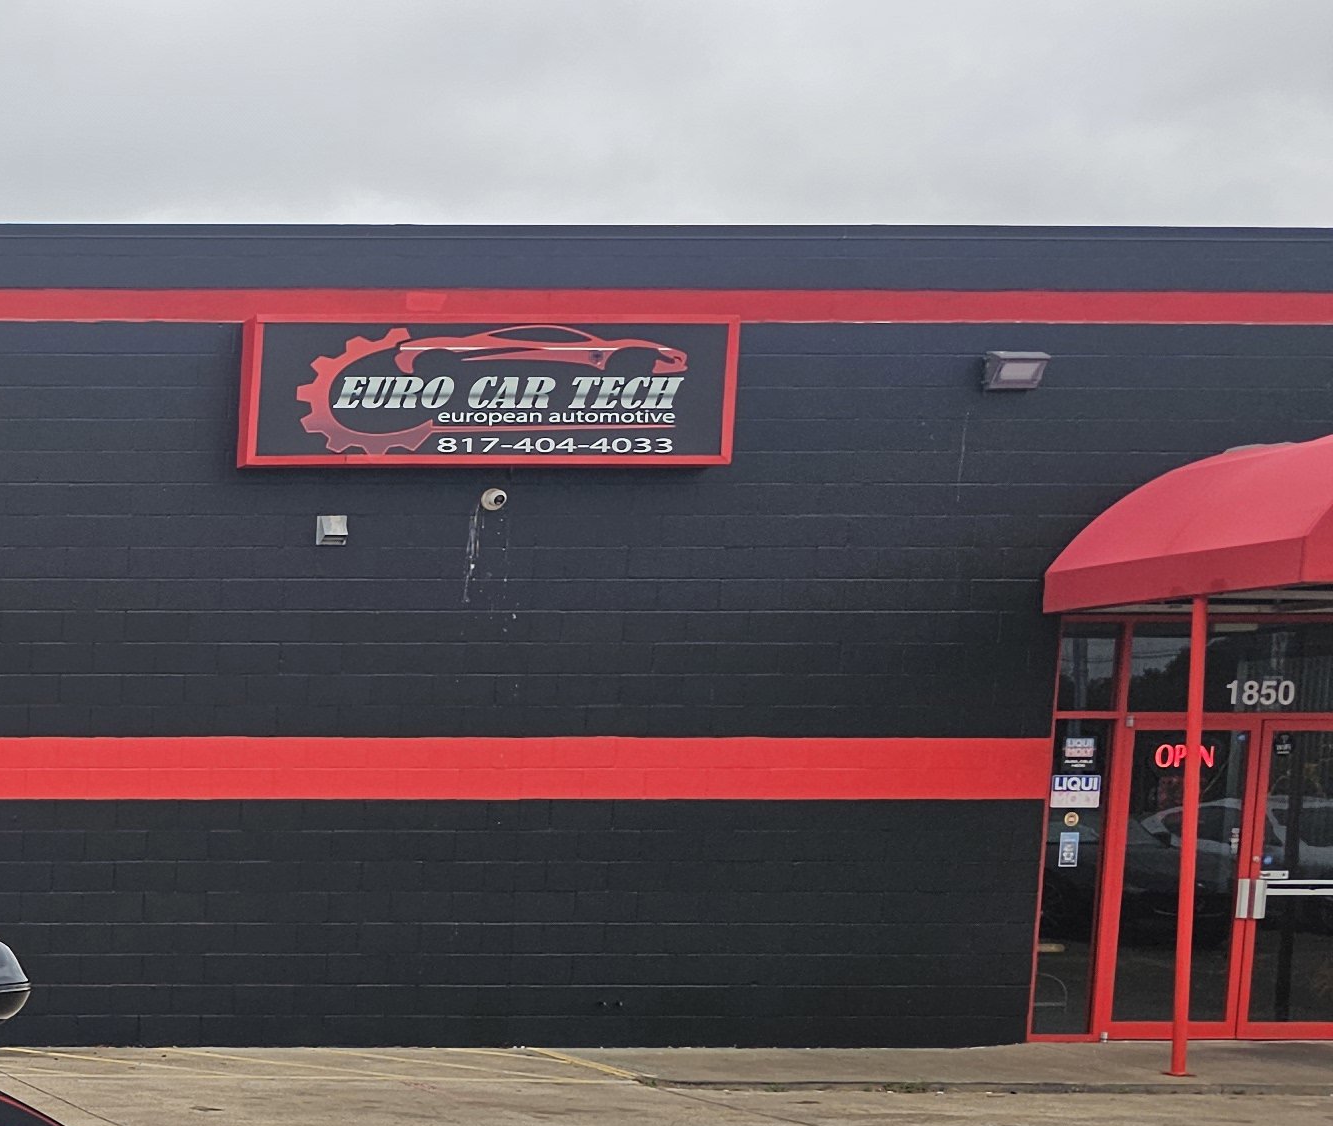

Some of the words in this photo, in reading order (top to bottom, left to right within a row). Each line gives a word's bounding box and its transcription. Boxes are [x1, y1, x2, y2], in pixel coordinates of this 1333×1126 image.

[333, 376, 455, 409] EURO
[468, 376, 556, 409] CAR
[568, 376, 684, 409] TECH
[438, 411, 542, 426] european
[548, 410, 676, 424] automotive
[437, 437, 673, 453] 817-404-4033
[1226, 679, 1295, 706] 1850
[1155, 744, 1215, 768] OPN
[1054, 776, 1099, 792] LIQUI
